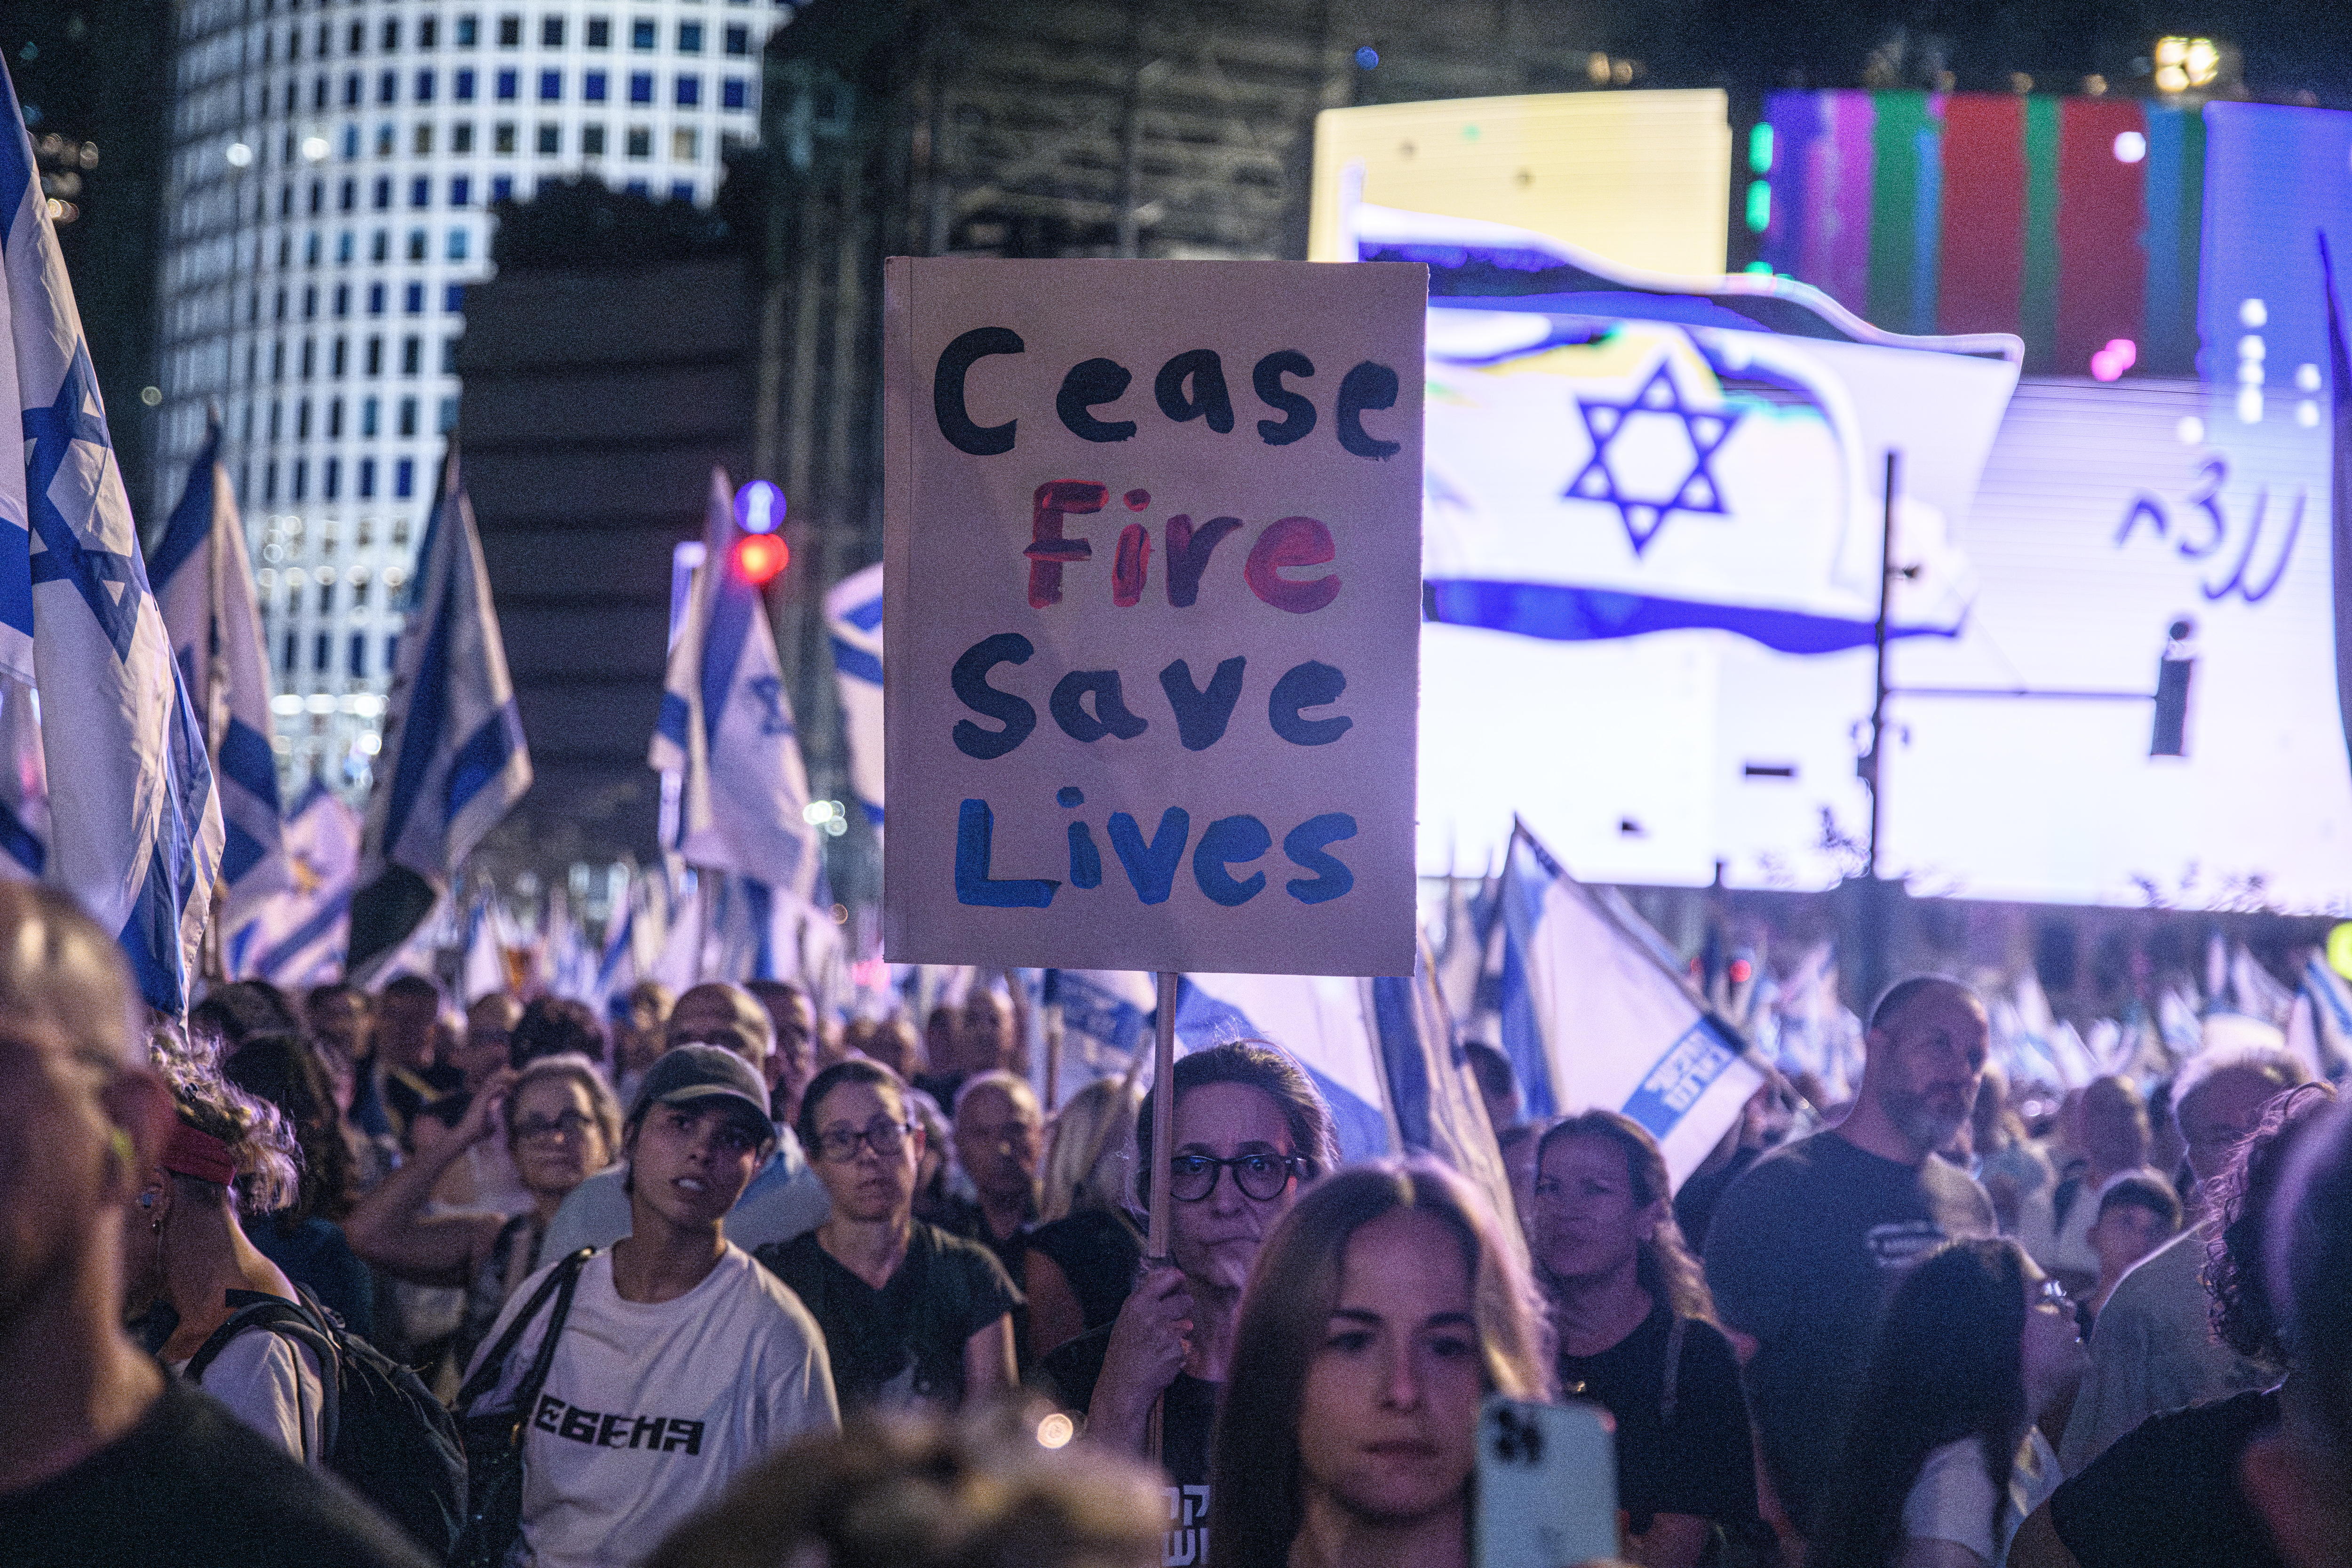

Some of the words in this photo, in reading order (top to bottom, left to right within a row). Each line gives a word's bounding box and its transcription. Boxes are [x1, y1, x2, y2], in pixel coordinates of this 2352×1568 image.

[933, 325, 1402, 461] Cease
[1023, 478, 1343, 614] Fire
[950, 632, 1354, 760] Save
[955, 785, 1359, 907] Lives
